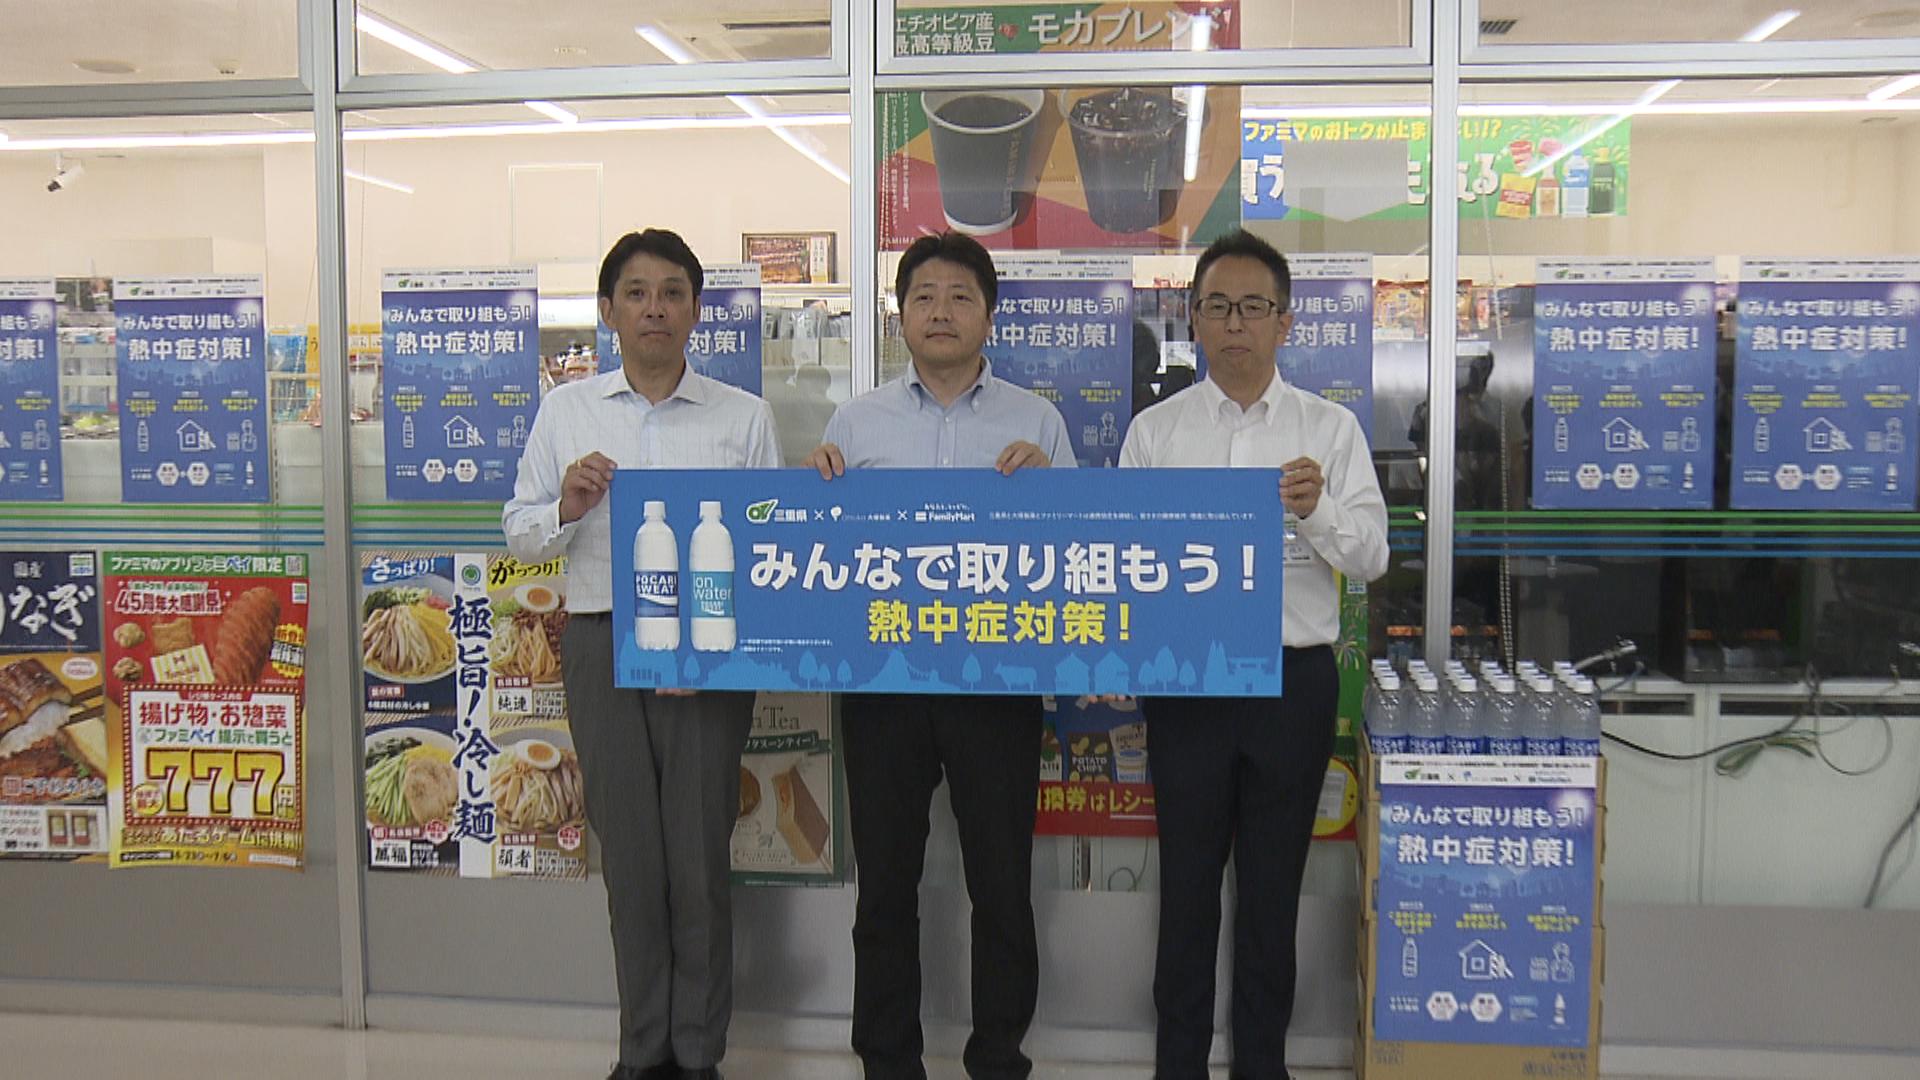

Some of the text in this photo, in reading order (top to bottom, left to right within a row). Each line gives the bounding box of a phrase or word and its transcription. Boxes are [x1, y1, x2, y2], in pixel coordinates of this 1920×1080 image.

[896, 11, 994, 32] エチオピア産
[389, 304, 531, 323] みんなで取り組もう!
[128, 337, 250, 361] 熱中症対策!
[395, 330, 524, 355] 熱中症対策!
[1550, 326, 1699, 352] 熱中症対策!
[1752, 326, 1907, 352] 熱中症対策!
[928, 511, 976, 524] FamilyMart
[370, 557, 437, 583] さっぱり!
[749, 541, 1255, 594] みんなで取り組もう！
[693, 588, 731, 600] water
[0, 584, 95, 641] なぎ
[868, 598, 1130, 645] 熱中症対策！
[139, 702, 287, 728] 揚げ物・お惣菜
[762, 706, 801, 730] Tea
[146, 747, 286, 816] 777
[1390, 804, 1585, 829] みんなで取り組もう!
[1398, 834, 1575, 867] 熱中症対策!
